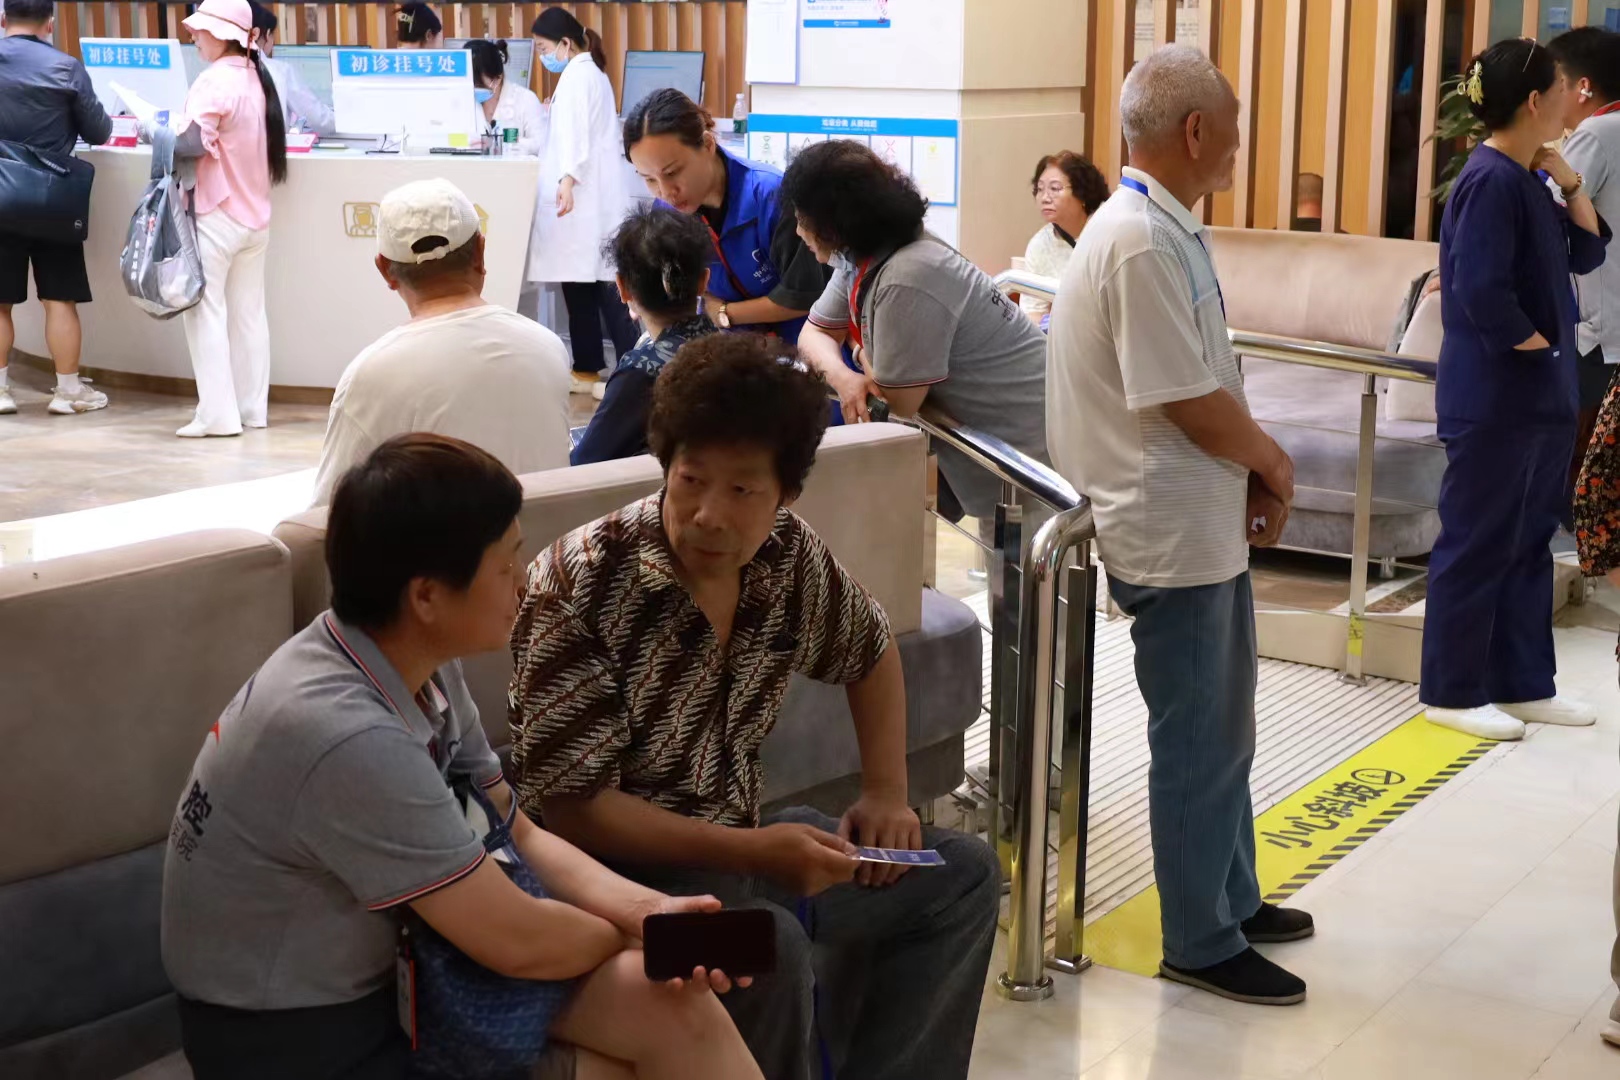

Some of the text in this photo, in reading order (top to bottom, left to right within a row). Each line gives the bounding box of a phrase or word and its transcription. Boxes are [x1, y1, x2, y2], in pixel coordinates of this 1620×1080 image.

[89, 46, 161, 66] 初诊挂号处
[351, 55, 456, 73] 初诊挂号处
[1260, 781, 1389, 849] 小心斜坡
